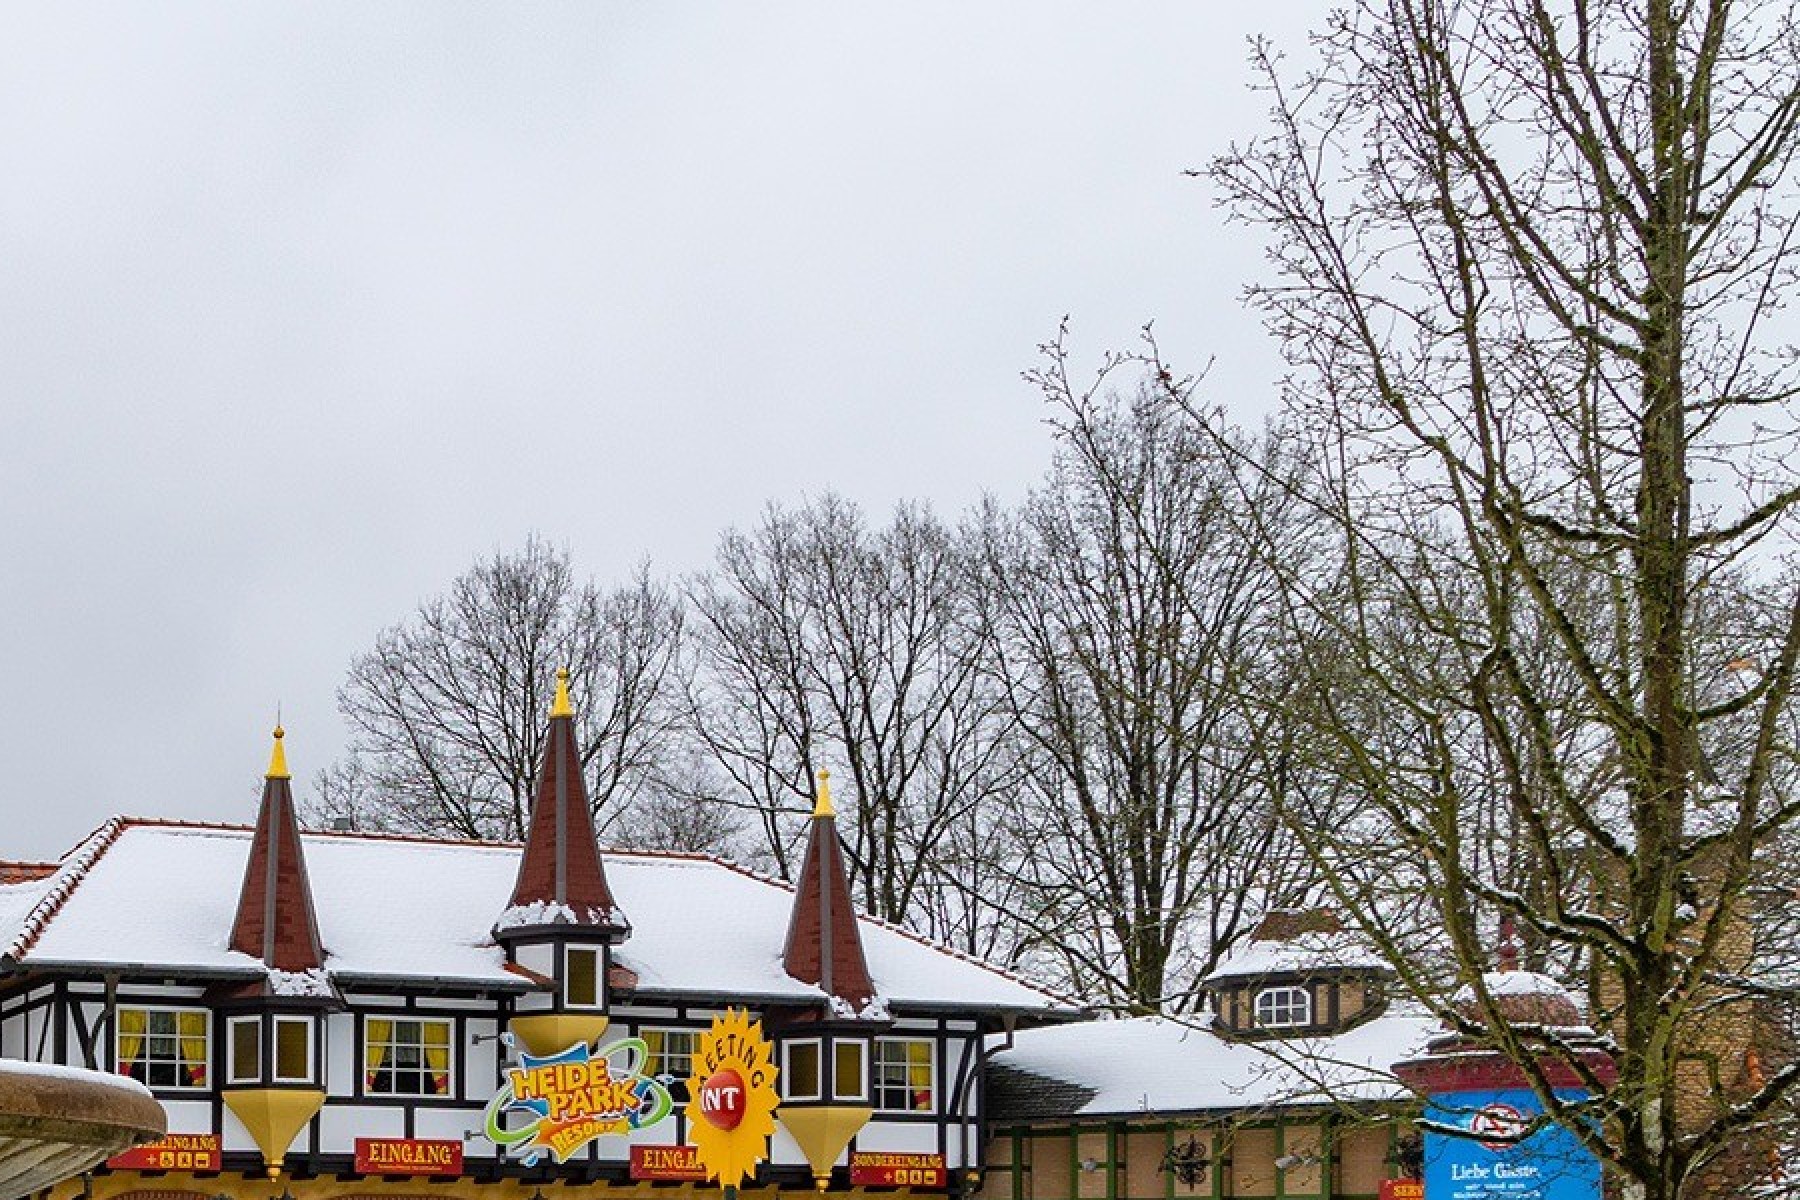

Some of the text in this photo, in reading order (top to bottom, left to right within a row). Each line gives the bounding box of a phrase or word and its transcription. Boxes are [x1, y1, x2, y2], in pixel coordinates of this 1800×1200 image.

[511, 1057, 609, 1100] HEIDE
[546, 1078, 640, 1121] PARK
[550, 1119, 616, 1149] RESORT
[368, 1142, 453, 1165] EINGANG
[643, 1149, 703, 1169] EINGA
[853, 1153, 943, 1169] SONDEREINGANG
[1451, 1163, 1490, 1180] Liebe
[1393, 1185, 1424, 1197] SERV
